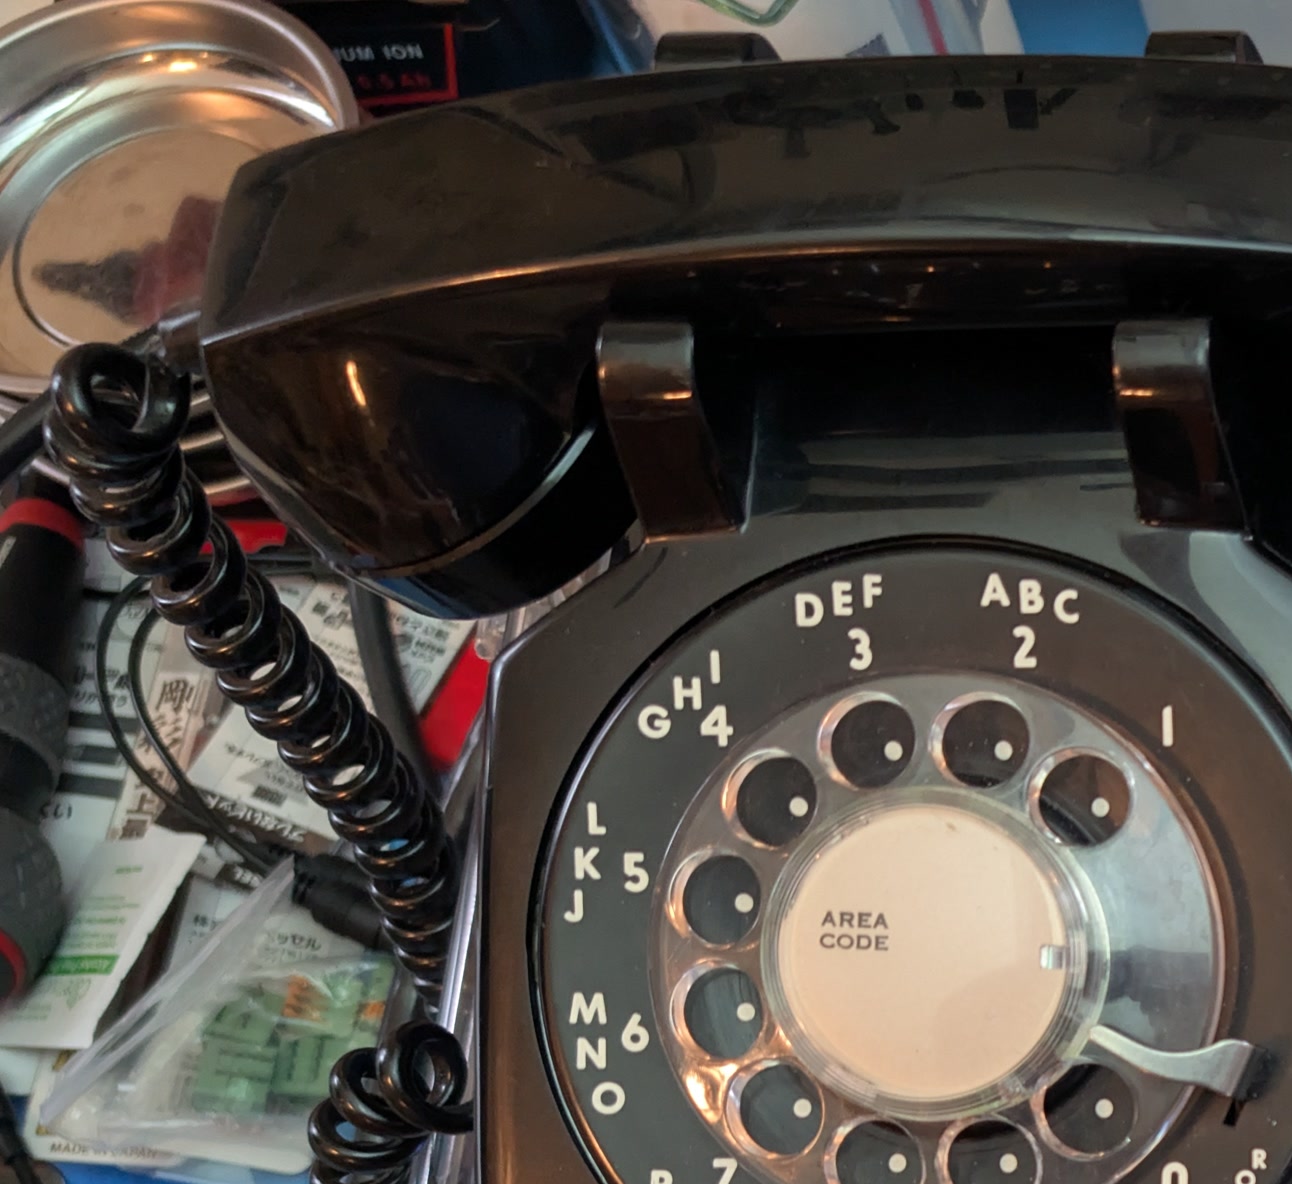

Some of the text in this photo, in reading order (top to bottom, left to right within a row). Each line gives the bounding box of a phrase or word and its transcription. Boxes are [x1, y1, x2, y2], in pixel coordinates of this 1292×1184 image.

[794, 573, 883, 628] DEF
[980, 572, 1081, 625] ABC
[847, 627, 873, 671] 3
[1012, 625, 1038, 669] 2
[637, 649, 721, 740] GHI
[700, 704, 734, 748] 4
[622, 851, 650, 894] 5
[819, 933, 890, 951] CODE
[820, 910, 890, 930] AREA
[621, 1012, 650, 1053] 6
